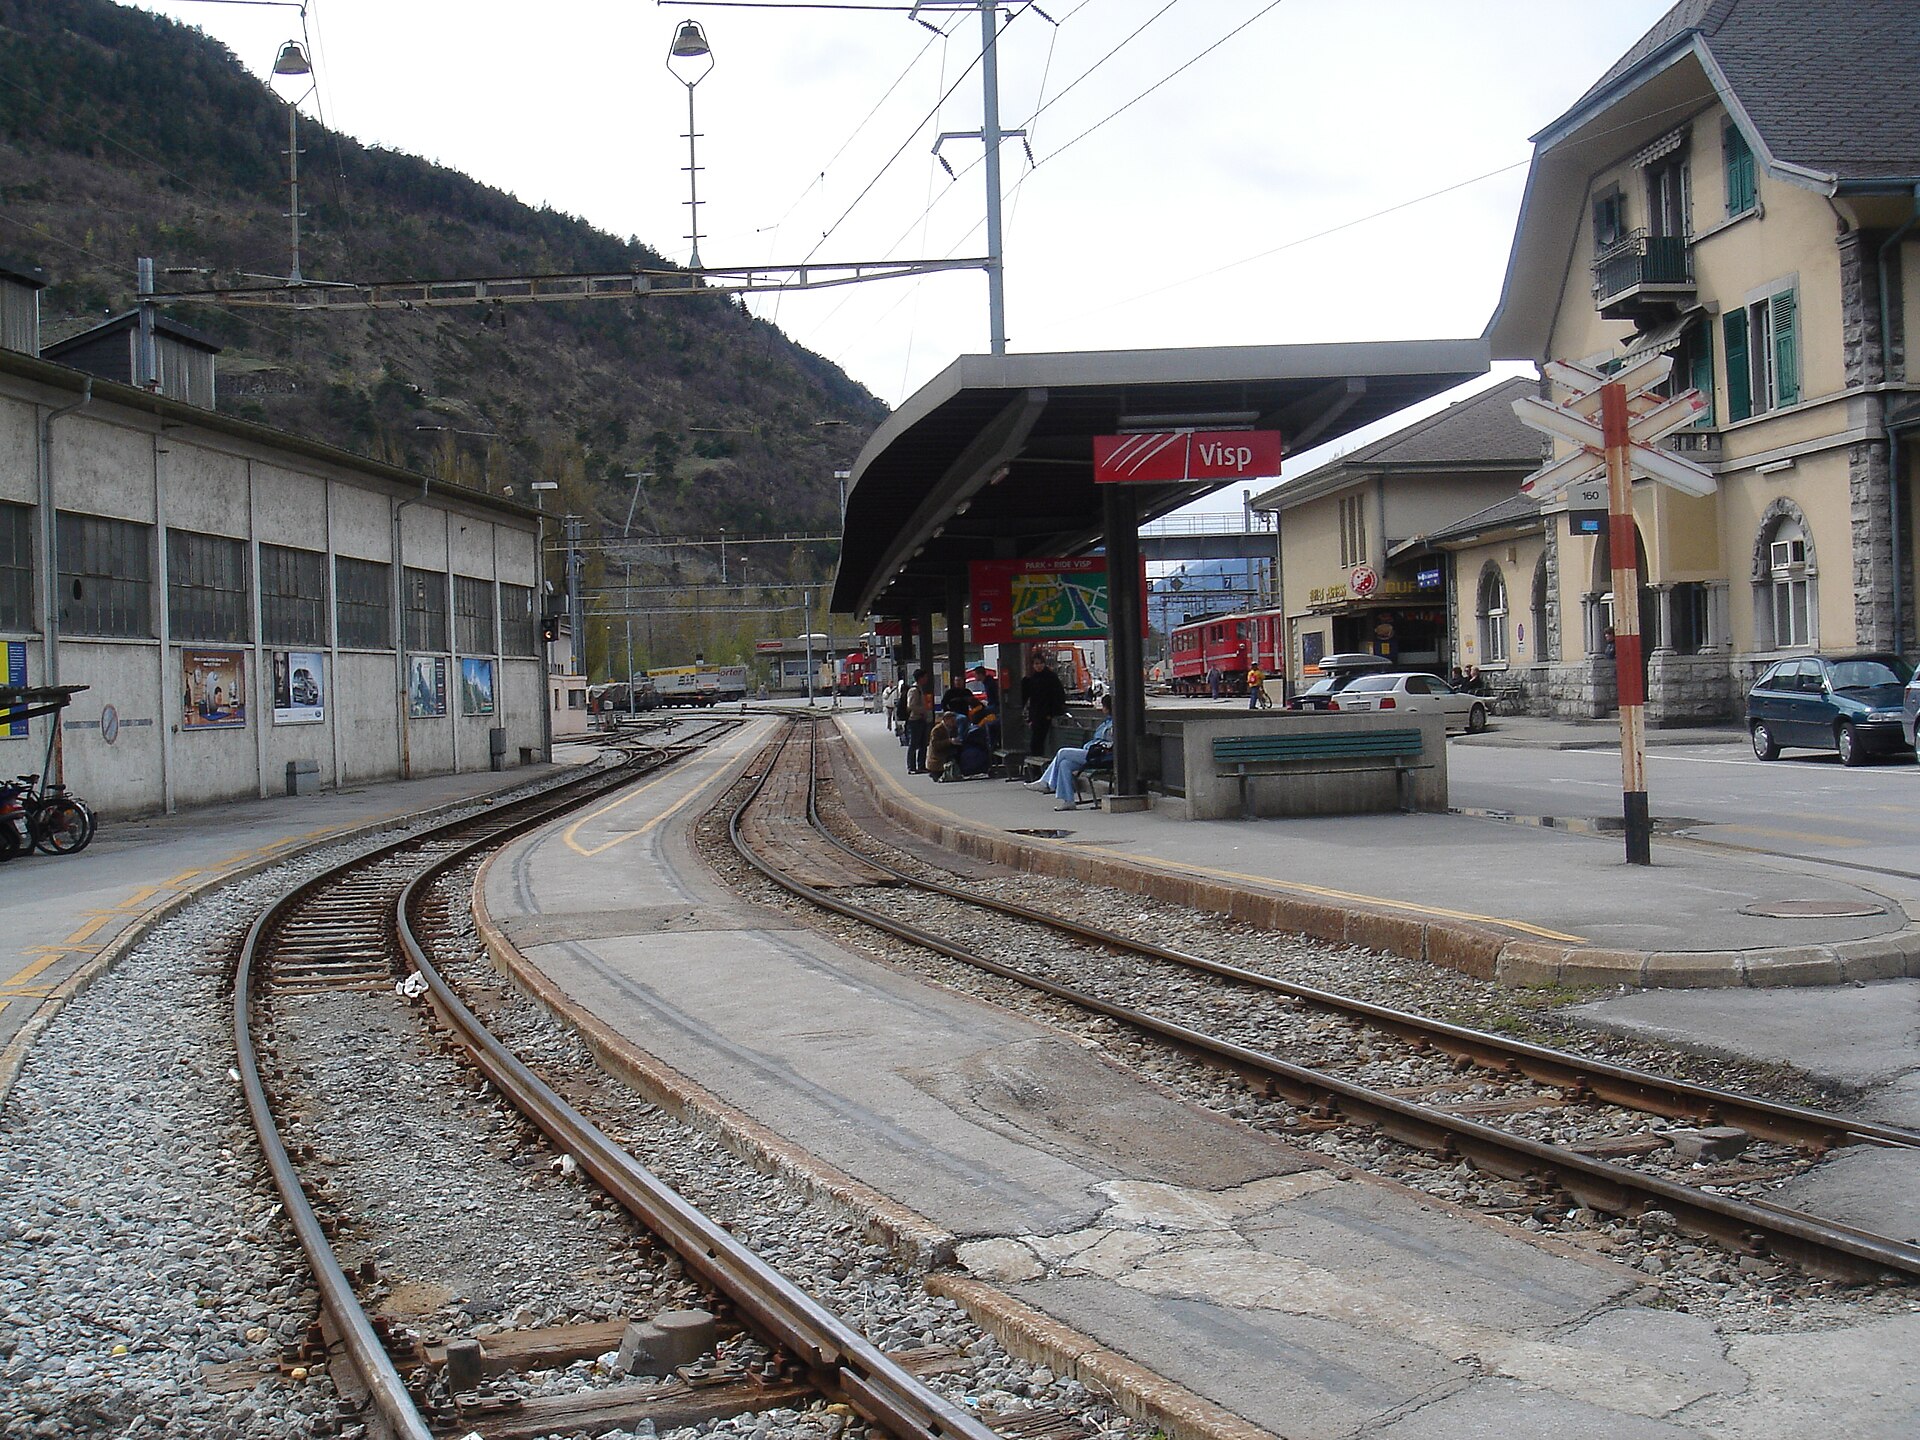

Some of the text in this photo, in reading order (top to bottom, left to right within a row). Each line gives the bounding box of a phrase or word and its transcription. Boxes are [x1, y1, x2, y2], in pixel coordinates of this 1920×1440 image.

[1199, 441, 1252, 471] Visp
[1582, 491, 1599, 500] 160
[1225, 578, 1231, 588] 7
